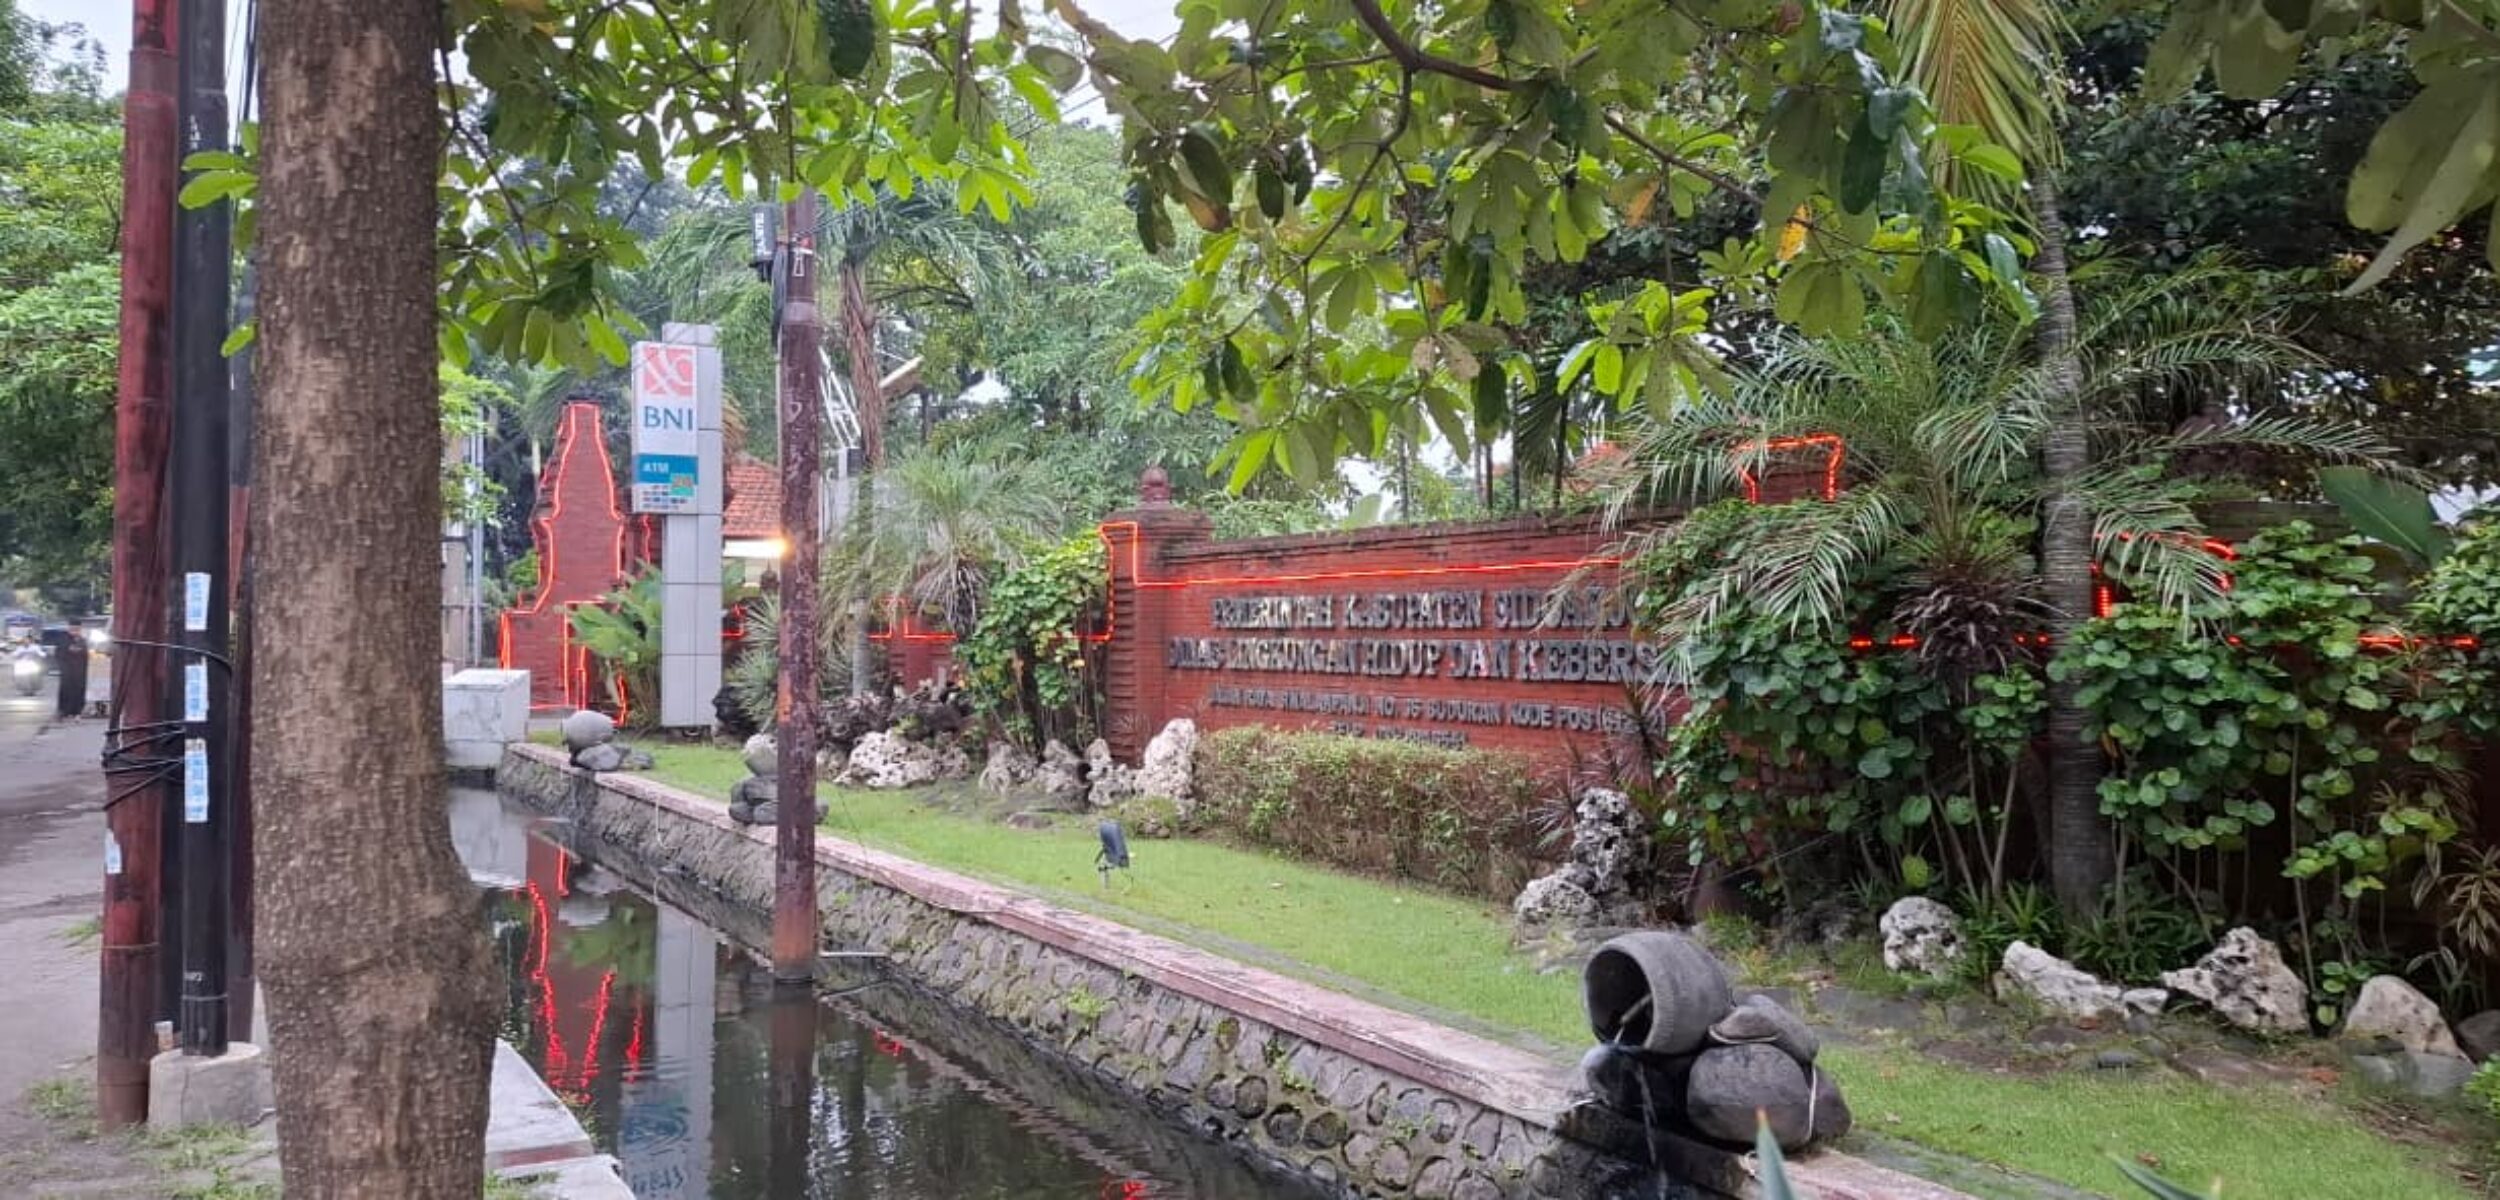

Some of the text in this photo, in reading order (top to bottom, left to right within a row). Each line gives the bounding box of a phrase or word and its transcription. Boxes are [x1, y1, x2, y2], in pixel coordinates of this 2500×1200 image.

[643, 406, 693, 430] BNI
[643, 462, 669, 472] ATM
[1212, 595, 1334, 628] PEMERINTAH
[1345, 588, 1482, 629] KABUPATEN
[1362, 638, 1443, 676] HIDUP
[1450, 638, 1513, 678] DAN
[1518, 639, 1690, 682] KEBERS
[1511, 703, 1553, 728] KODE
[1557, 706, 1594, 731] POS
